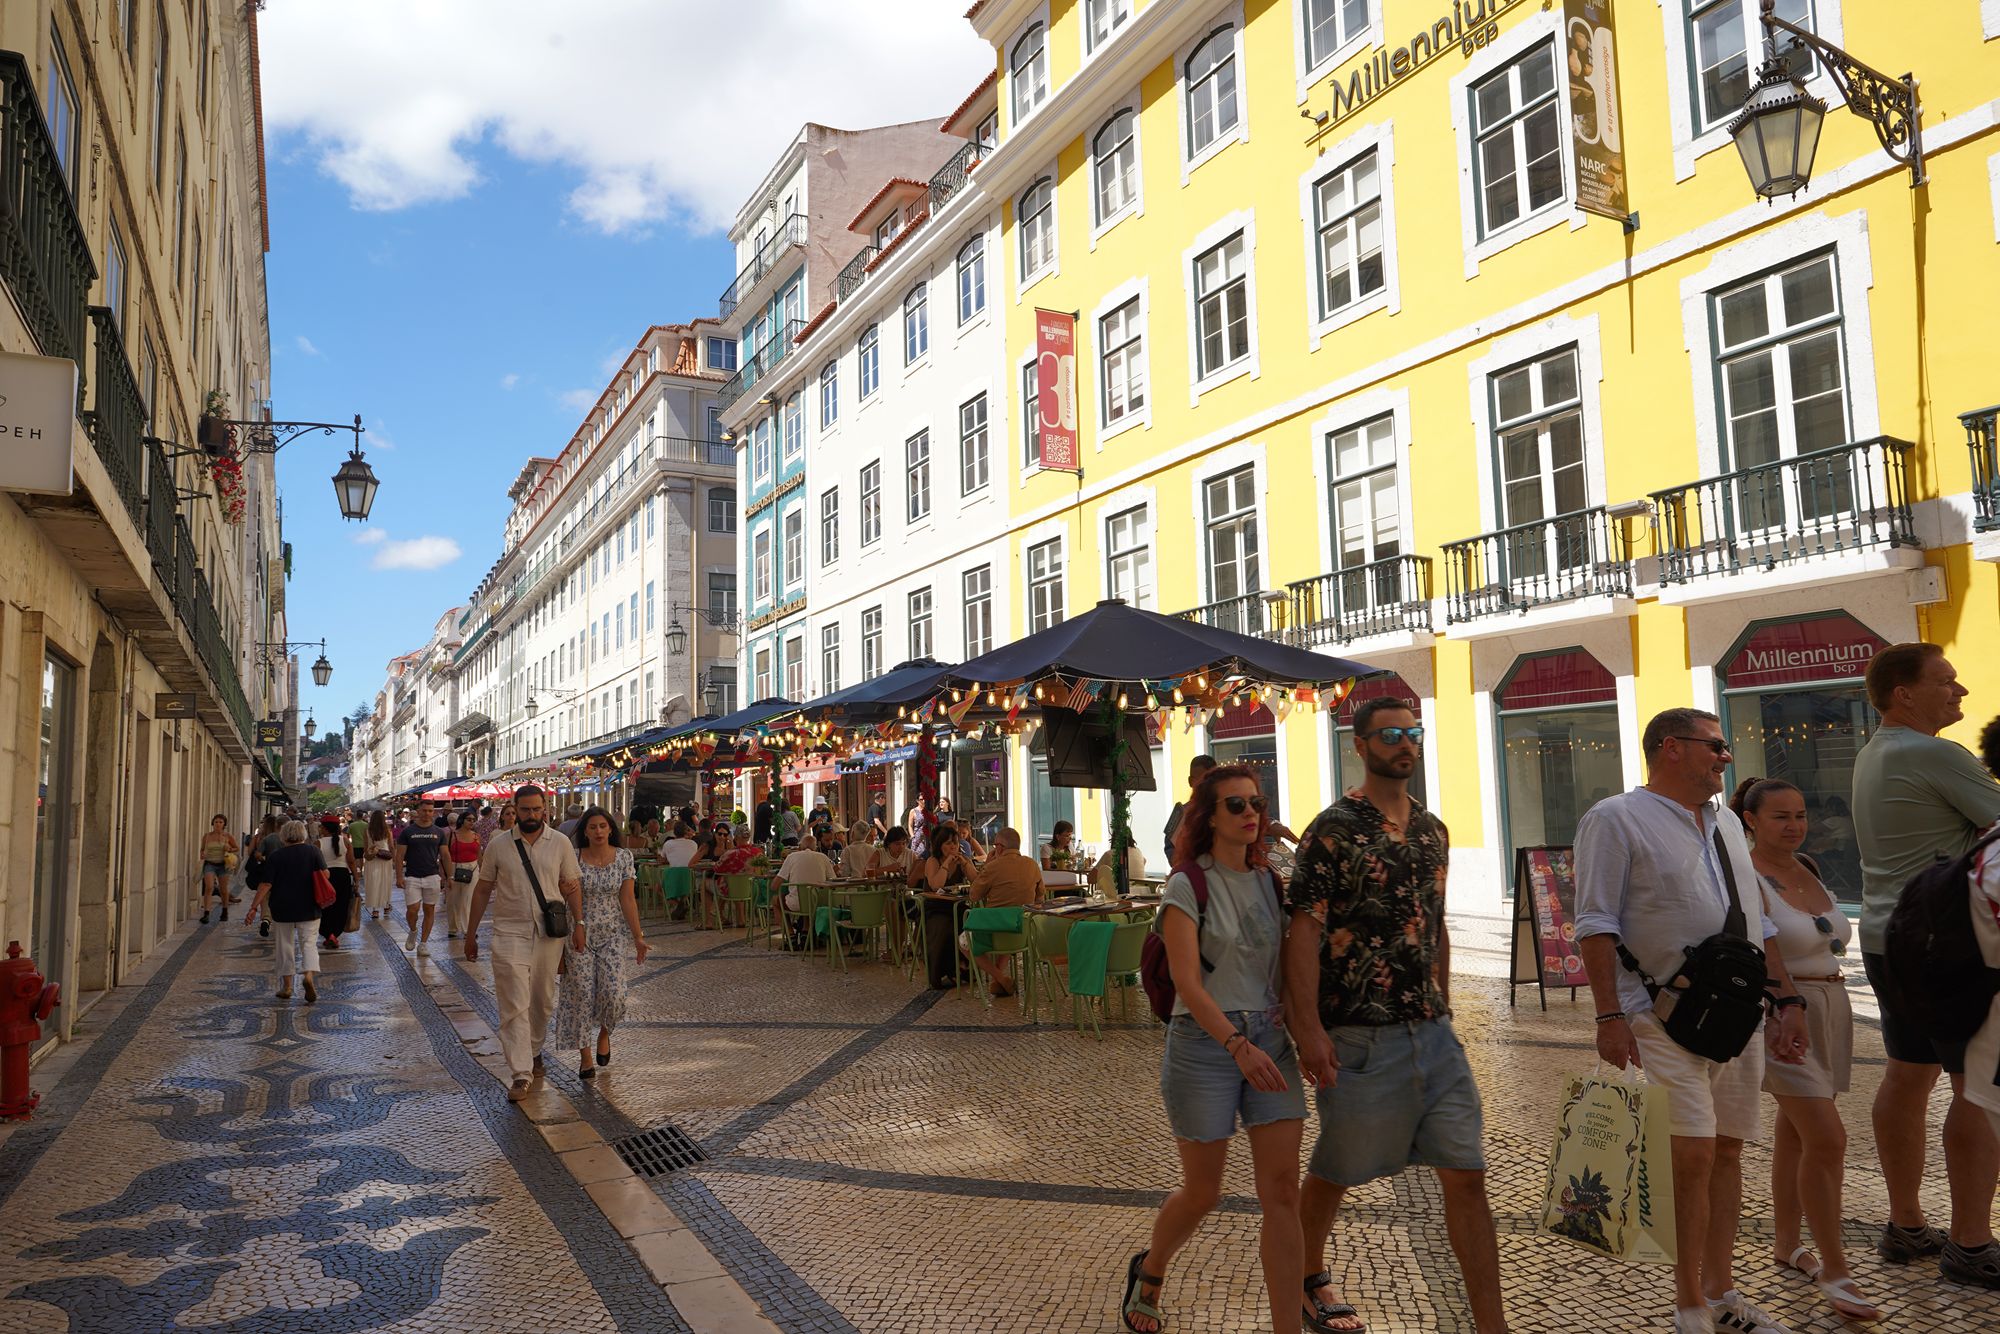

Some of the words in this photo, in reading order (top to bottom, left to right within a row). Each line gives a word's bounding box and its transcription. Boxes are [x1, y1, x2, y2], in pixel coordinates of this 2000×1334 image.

[1461, 20, 1498, 57] bcp
[1580, 156, 1607, 175] NARC
[1745, 643, 1873, 671] Millennium
[1833, 663, 1856, 674] bcp
[1585, 1112, 1615, 1126] WELCOME
[1593, 1121, 1609, 1129] your
[1577, 1125, 1621, 1143] COMFORT
[1582, 1136, 1607, 1150] ZONE
